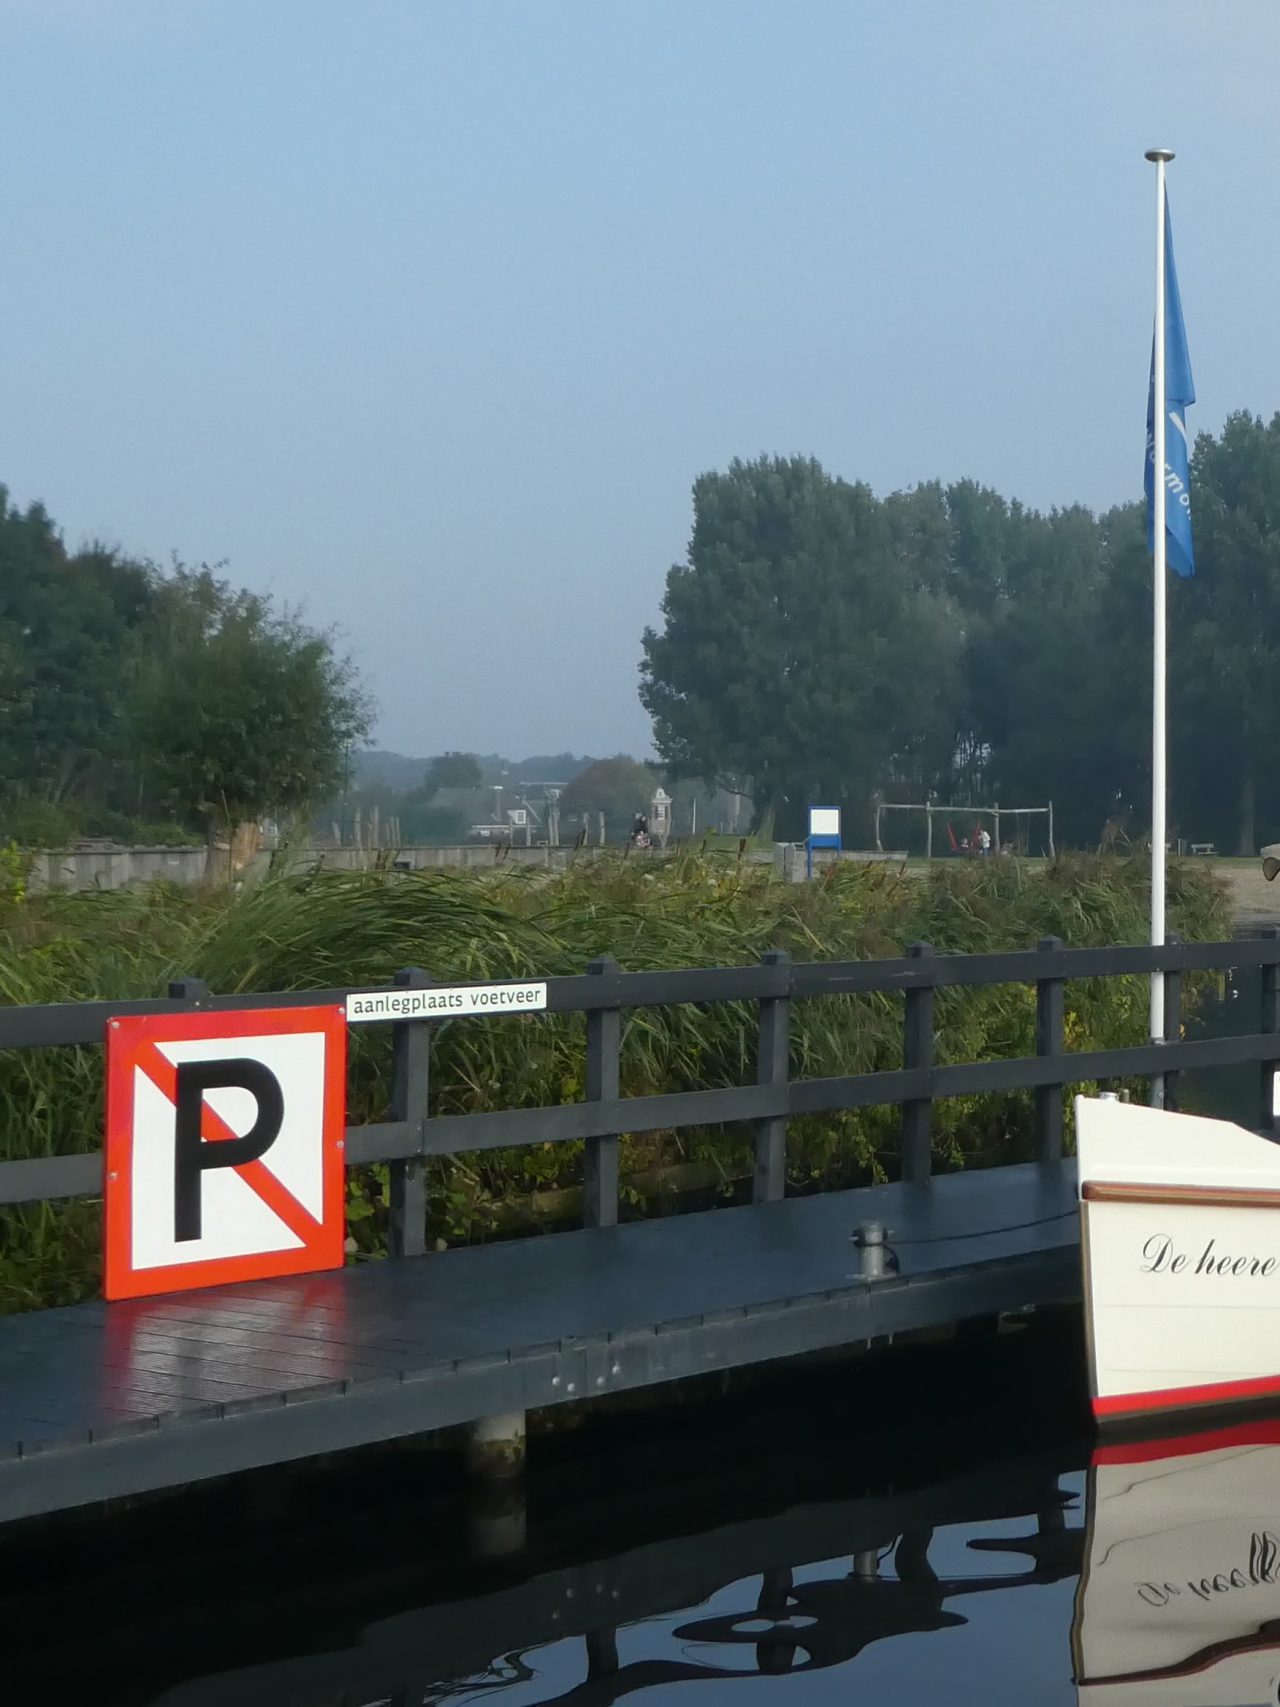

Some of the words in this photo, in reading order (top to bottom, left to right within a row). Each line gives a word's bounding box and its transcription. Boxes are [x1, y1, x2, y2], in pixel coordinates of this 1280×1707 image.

[354, 993, 463, 1014] aanlegplaats
[470, 989, 541, 1006] voetveer
[174, 1057, 285, 1243] P
[1140, 1233, 1187, 1274] De
[1194, 1238, 1278, 1277] heere
